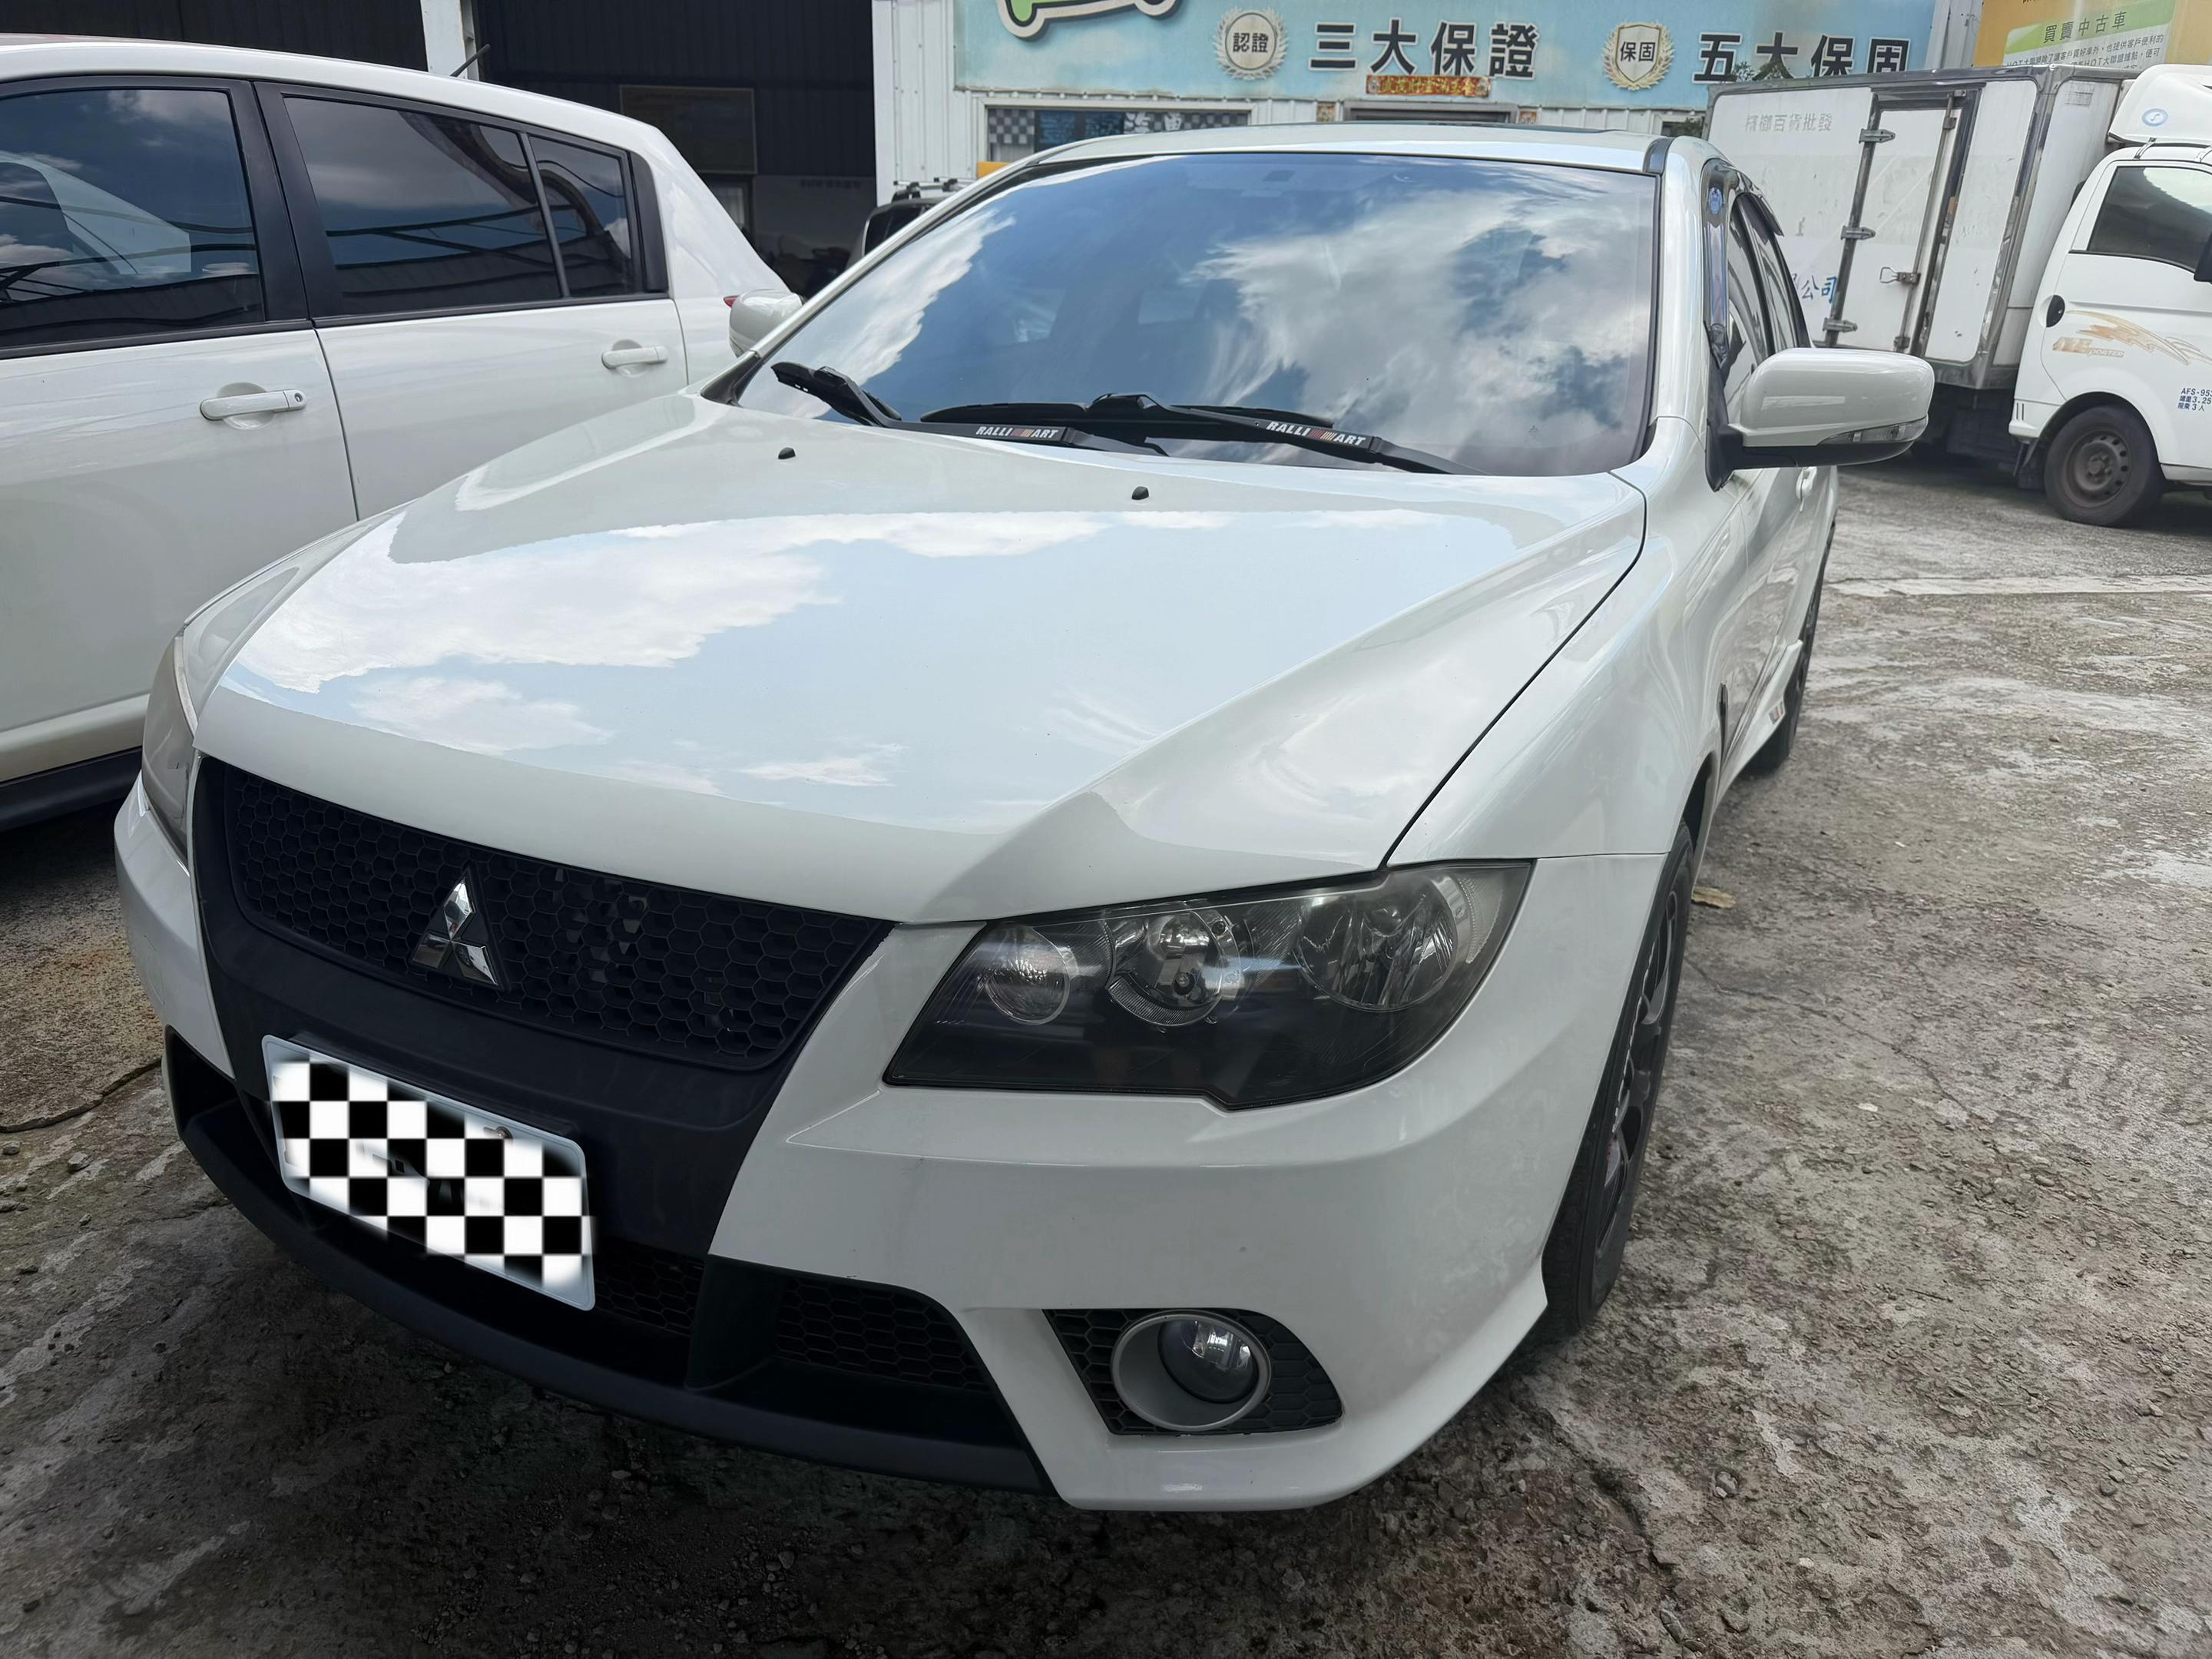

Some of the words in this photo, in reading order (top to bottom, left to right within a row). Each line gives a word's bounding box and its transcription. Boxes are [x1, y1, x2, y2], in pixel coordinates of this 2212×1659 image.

[2043, 11, 2127, 44] 買賣中古車
[1232, 32, 1269, 53] 認證
[1309, 18, 1538, 78] 三大保證
[1619, 41, 1656, 62] 保固
[1694, 31, 1909, 81] 五大保固
[975, 426, 1013, 437] RALLI
[1030, 429, 1058, 439] ART
[1267, 422, 1311, 437] RALLI
[1333, 433, 1366, 445] ART
